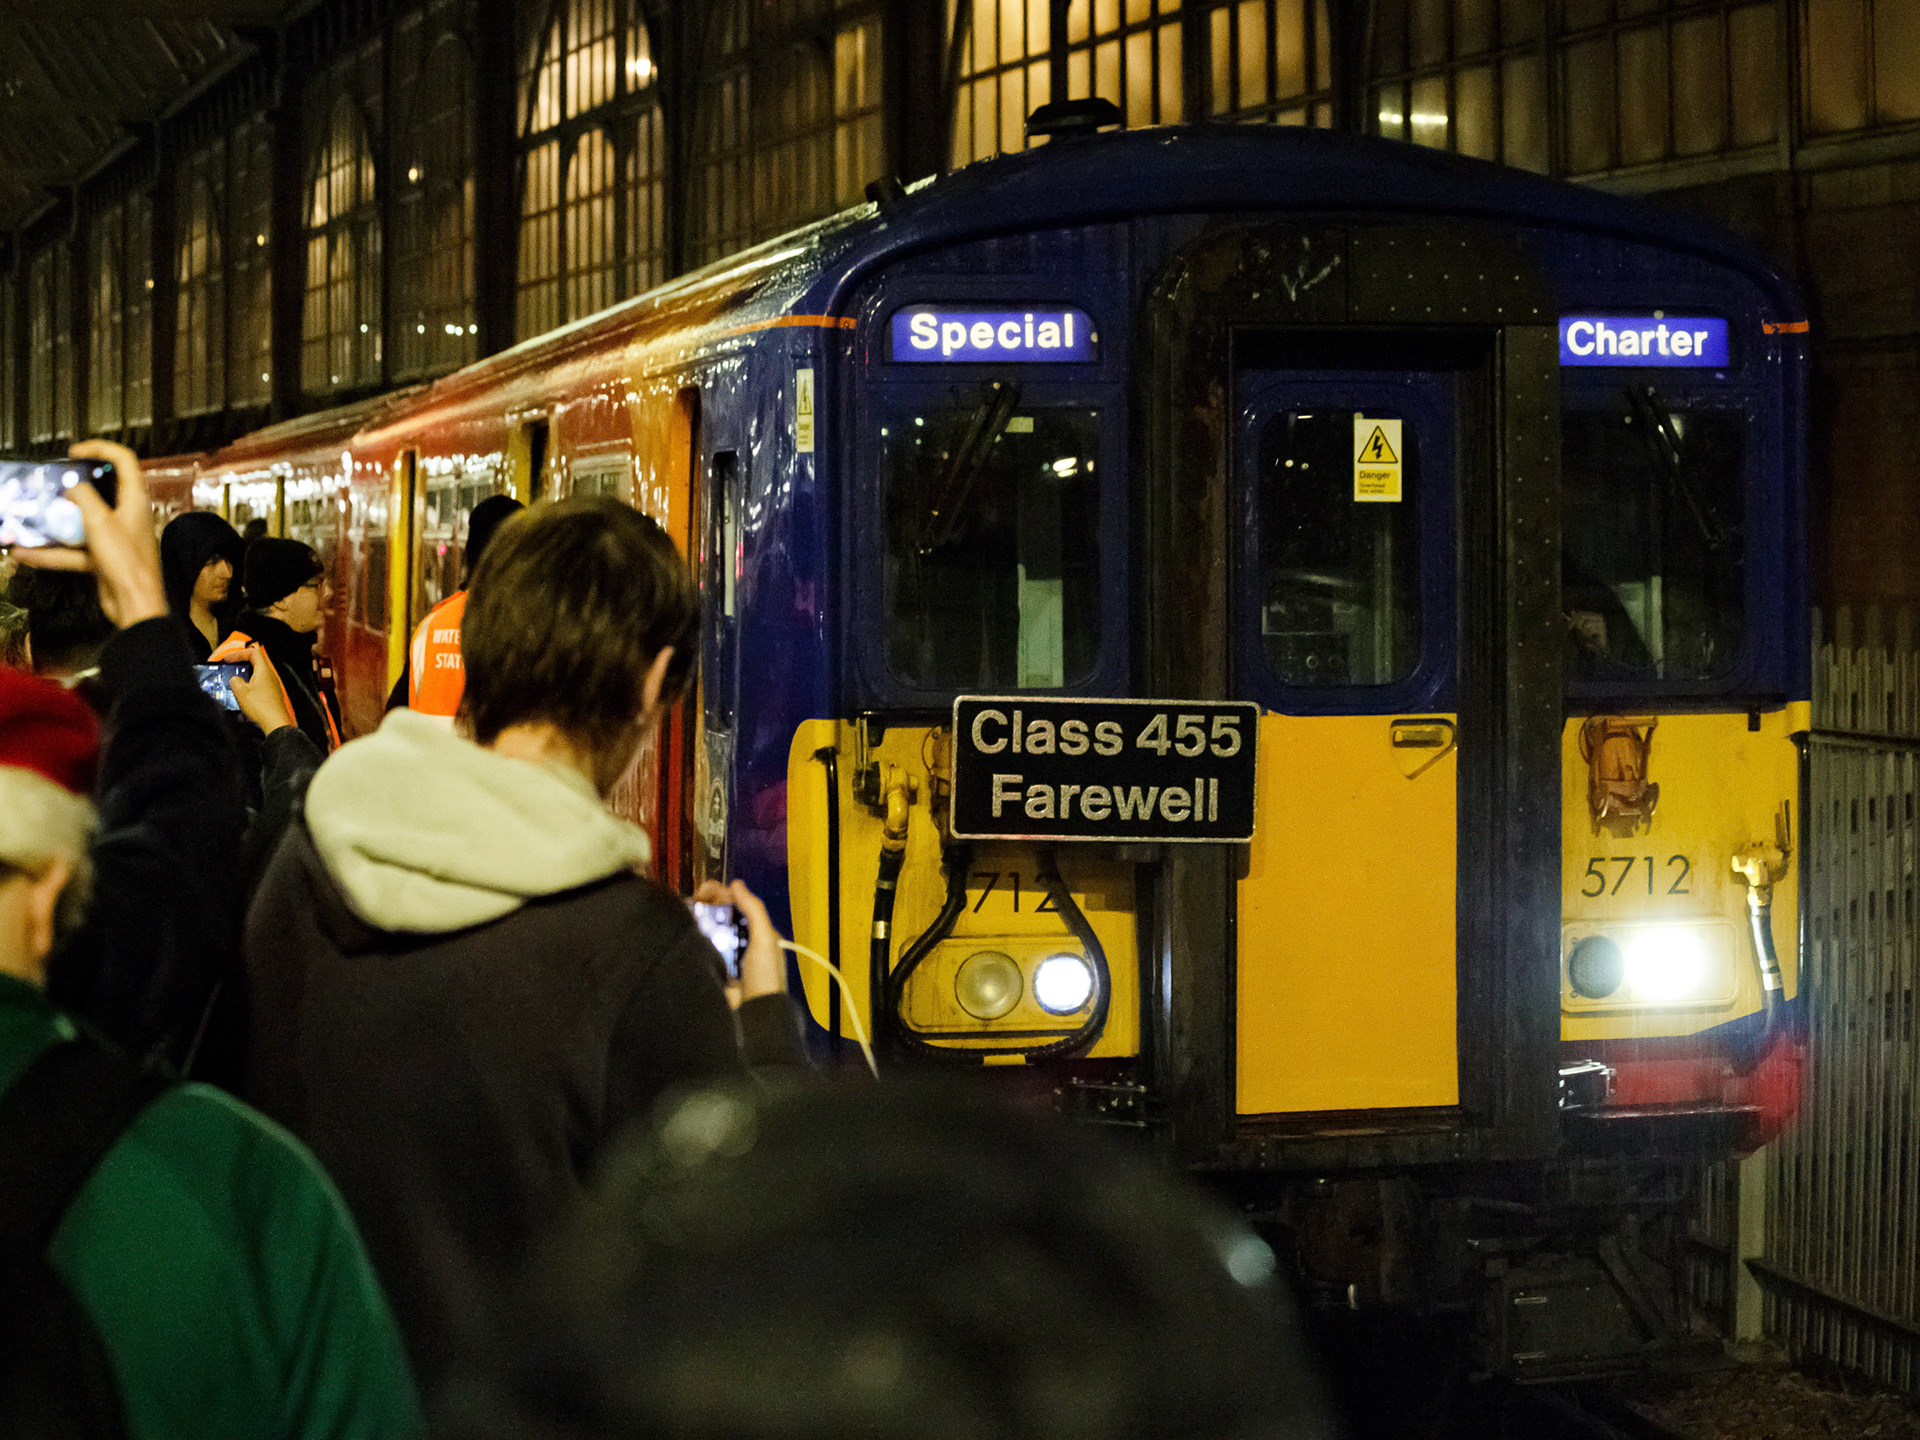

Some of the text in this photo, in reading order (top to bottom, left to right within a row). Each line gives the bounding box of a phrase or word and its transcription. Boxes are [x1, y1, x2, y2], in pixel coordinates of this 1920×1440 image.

[909, 312, 1074, 356] Special
[1566, 320, 1708, 356] Charter
[1359, 470, 1391, 481] Danger
[432, 628, 461, 644] WATE
[435, 652, 464, 670] STAT
[971, 709, 1242, 758] Class 455
[991, 773, 1219, 823] Farewell
[966, 871, 1060, 914] 712
[1581, 854, 1690, 898] 5712
